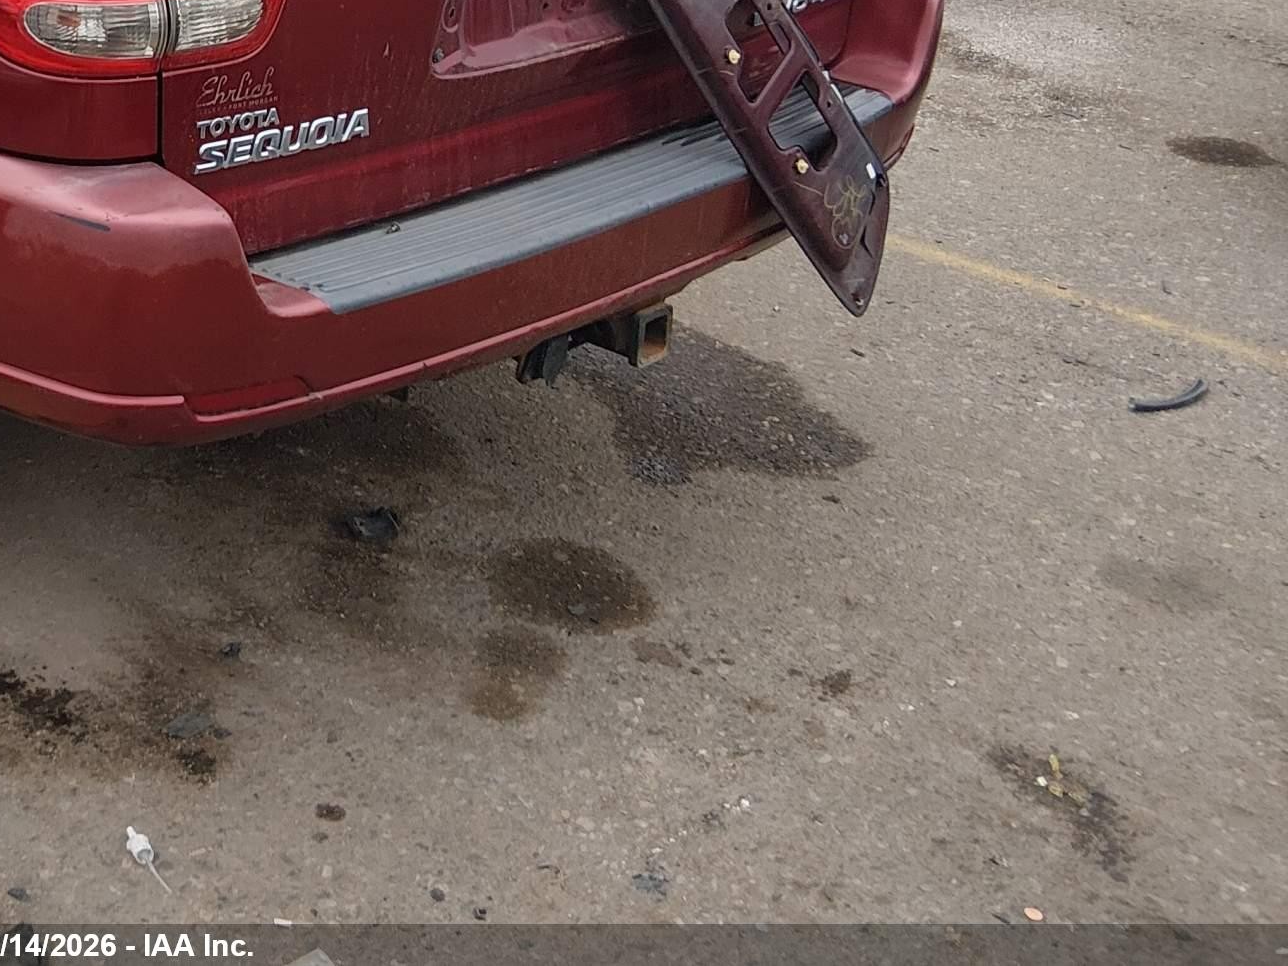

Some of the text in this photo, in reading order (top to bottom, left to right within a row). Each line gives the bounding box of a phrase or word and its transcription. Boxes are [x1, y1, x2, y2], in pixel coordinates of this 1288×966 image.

[196, 66, 275, 107] Ehrlich
[193, 108, 370, 175] SEQUOIA
[195, 108, 281, 140] TOYOTA
